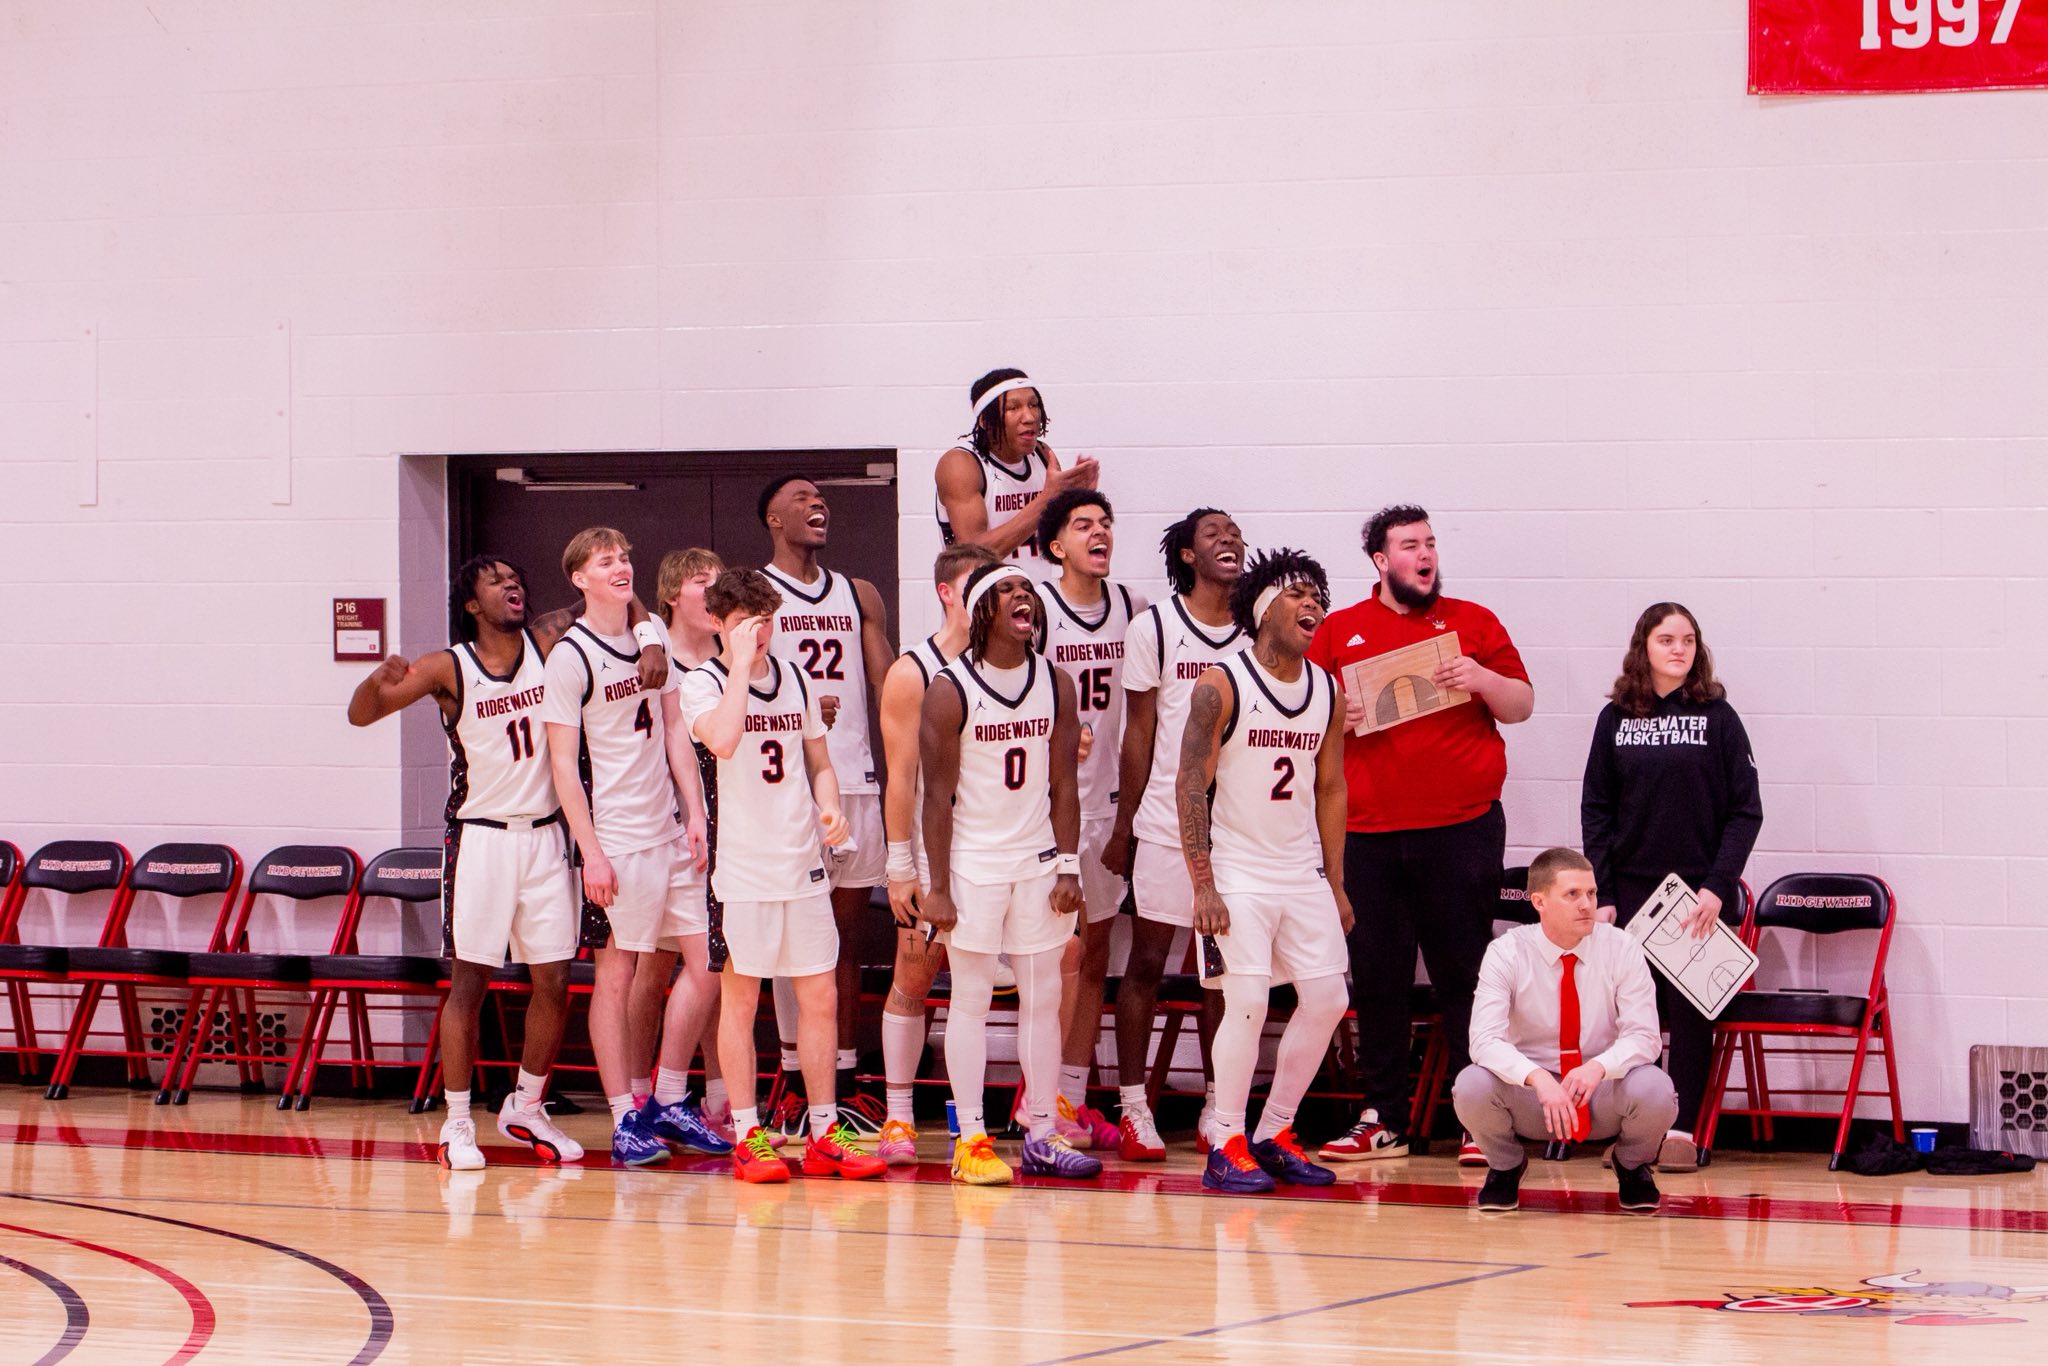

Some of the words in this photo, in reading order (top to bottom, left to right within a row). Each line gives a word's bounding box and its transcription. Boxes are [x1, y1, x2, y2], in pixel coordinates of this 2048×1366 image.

[1858, 0, 2021, 50] 1997
[336, 602, 356, 613] P16
[780, 615, 853, 633] RIDGEWATER
[799, 638, 844, 680] 22
[1078, 667, 1113, 711] 15
[634, 698, 653, 739] 4
[743, 713, 803, 733] DGEWATER
[1620, 716, 1708, 732] RIDGEWATER
[506, 716, 535, 762] 11
[975, 717, 1050, 742] RIDGEWATER
[1248, 729, 1320, 750] RIDGEWATER
[1615, 730, 1708, 746] BASKETBALL
[760, 739, 785, 784] 3
[1004, 747, 1027, 790] 0
[1271, 756, 1295, 801] 2
[39, 859, 111, 871] RIDGEWATER
[147, 862, 221, 875] RIDGEWATER
[267, 865, 342, 877] RIDGEWATER
[1776, 894, 1871, 908] RIDGEWATER
